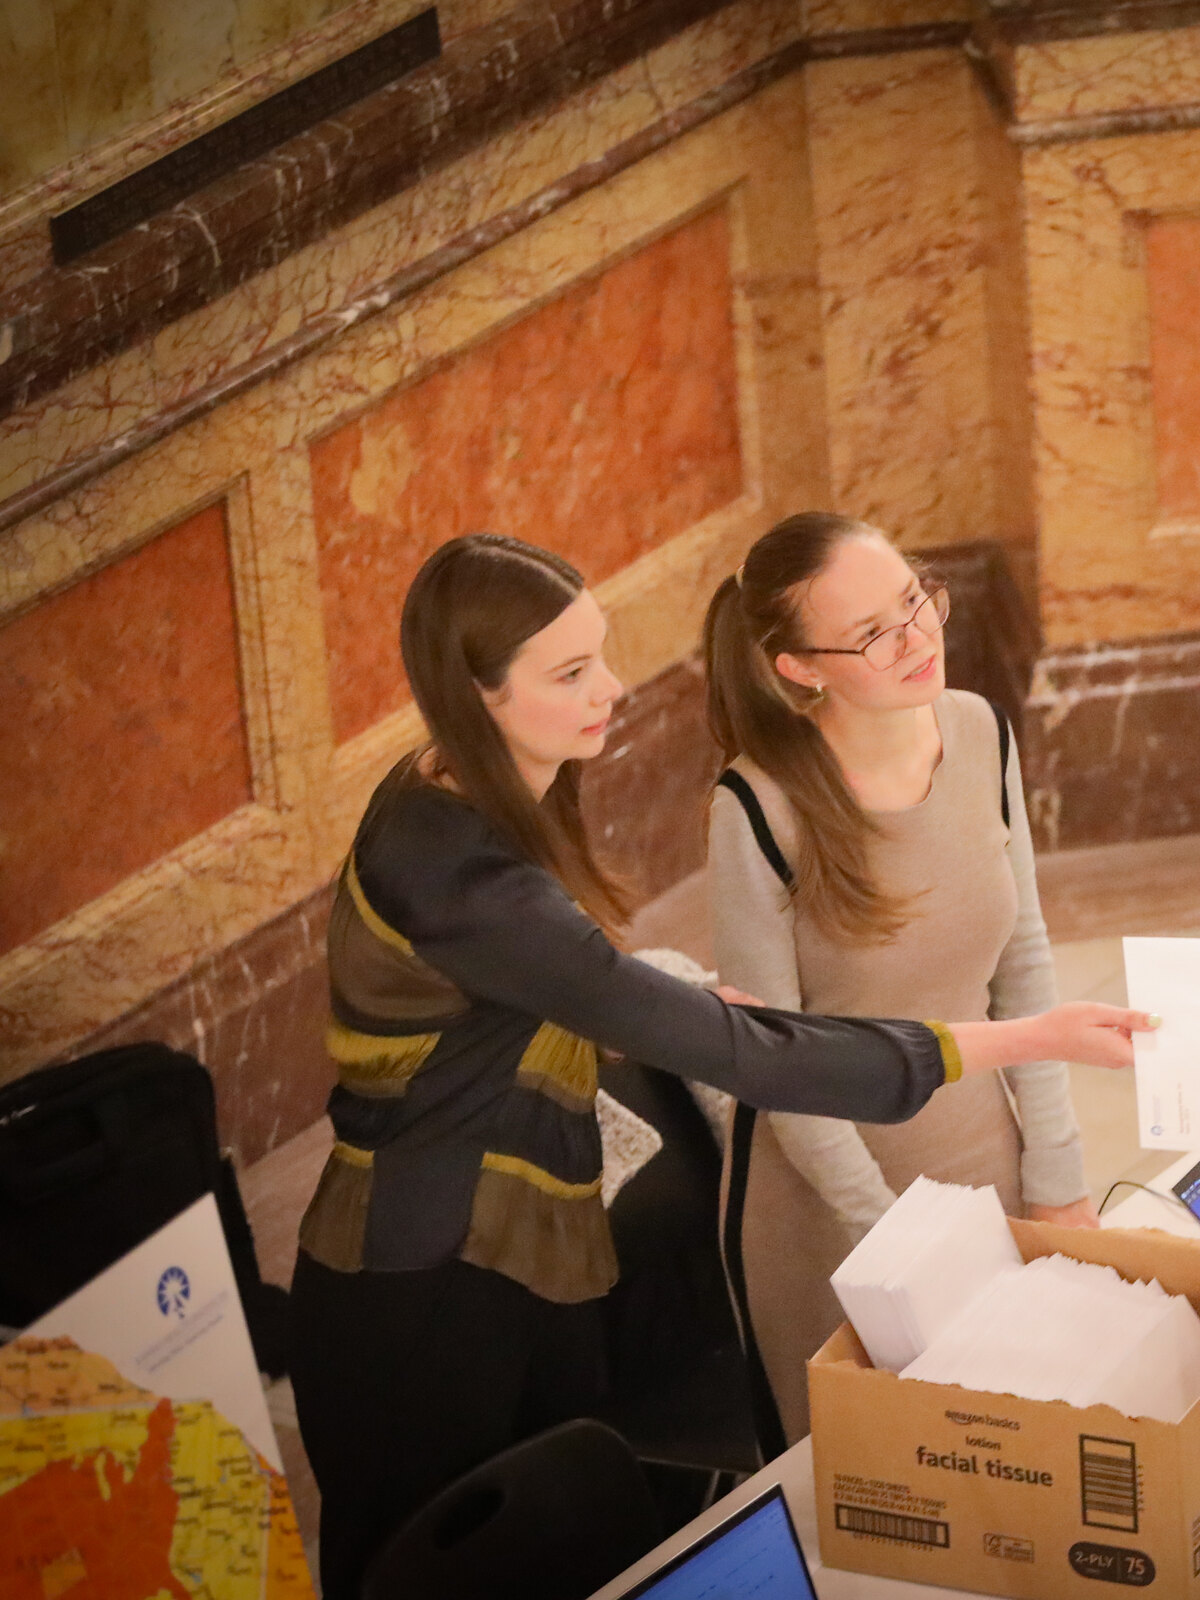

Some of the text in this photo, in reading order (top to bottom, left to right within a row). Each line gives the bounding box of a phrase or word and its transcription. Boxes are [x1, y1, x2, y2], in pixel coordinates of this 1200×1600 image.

[965, 1436, 1002, 1451] lotion
[916, 1446, 1053, 1487] facial tissue
[1075, 1551, 1145, 1576] 2-PLY 75
